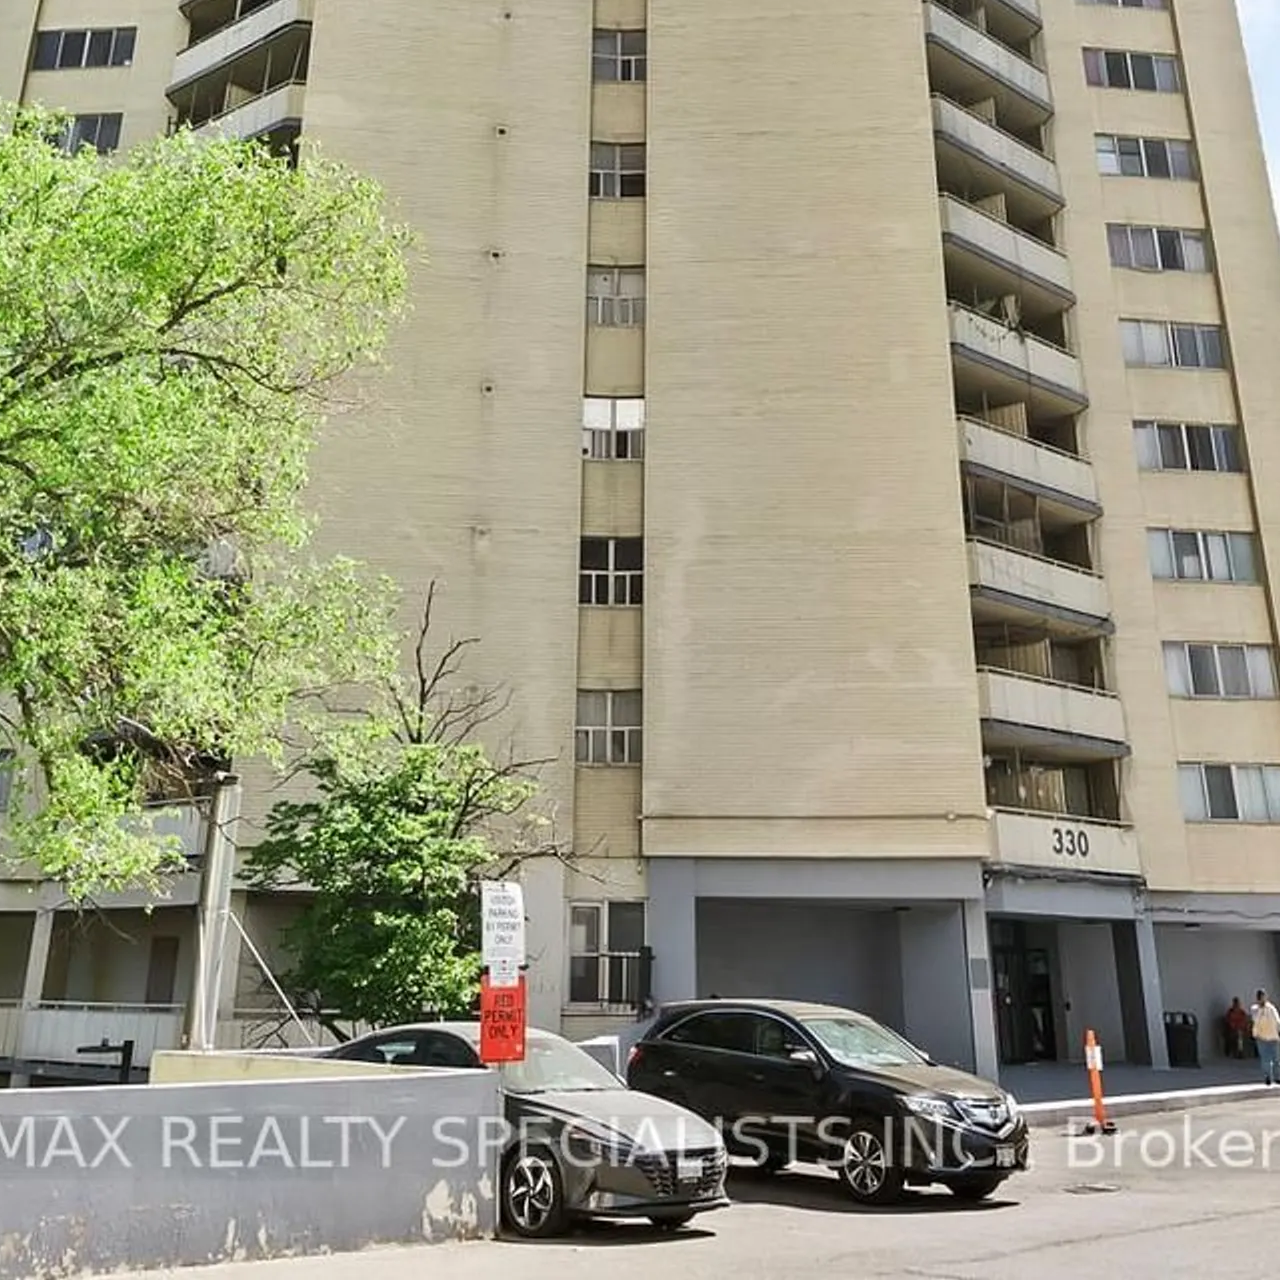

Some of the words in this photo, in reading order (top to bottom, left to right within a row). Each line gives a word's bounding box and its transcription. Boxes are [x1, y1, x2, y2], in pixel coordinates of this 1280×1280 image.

[1052, 828, 1089, 857] 330
[488, 907, 519, 919] PARKING
[486, 921, 495, 932] BY
[496, 922, 521, 933] PERMIT
[494, 933, 513, 945] ONLY
[494, 992, 513, 1008] RED
[483, 1008, 523, 1024] PERMIT
[488, 1023, 518, 1040] ONLY
